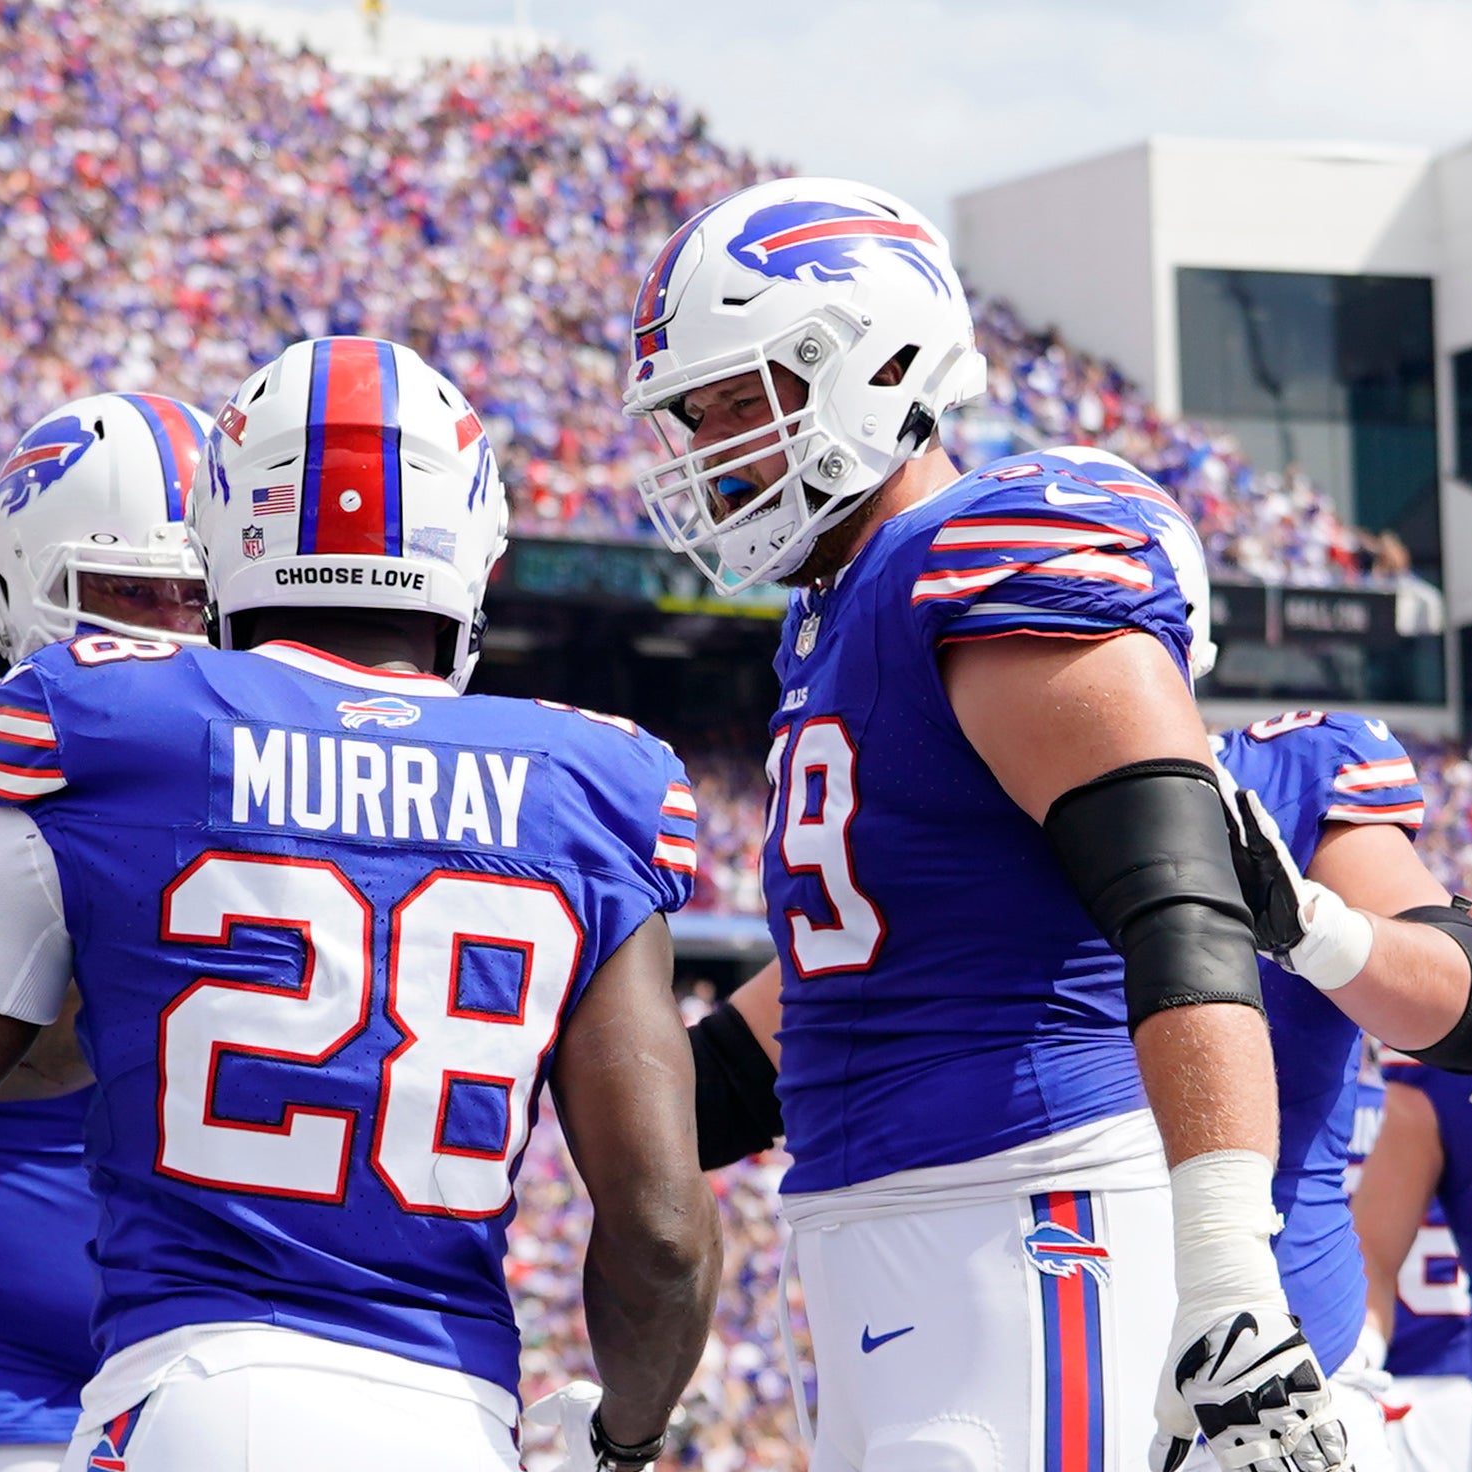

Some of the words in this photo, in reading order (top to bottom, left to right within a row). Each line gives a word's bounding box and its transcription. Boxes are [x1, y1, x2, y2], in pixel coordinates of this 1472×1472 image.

[275, 567, 364, 586] CHOOSE
[371, 568, 425, 591] LOVE
[232, 728, 529, 848] MURRAY
[154, 850, 585, 1220] 28
